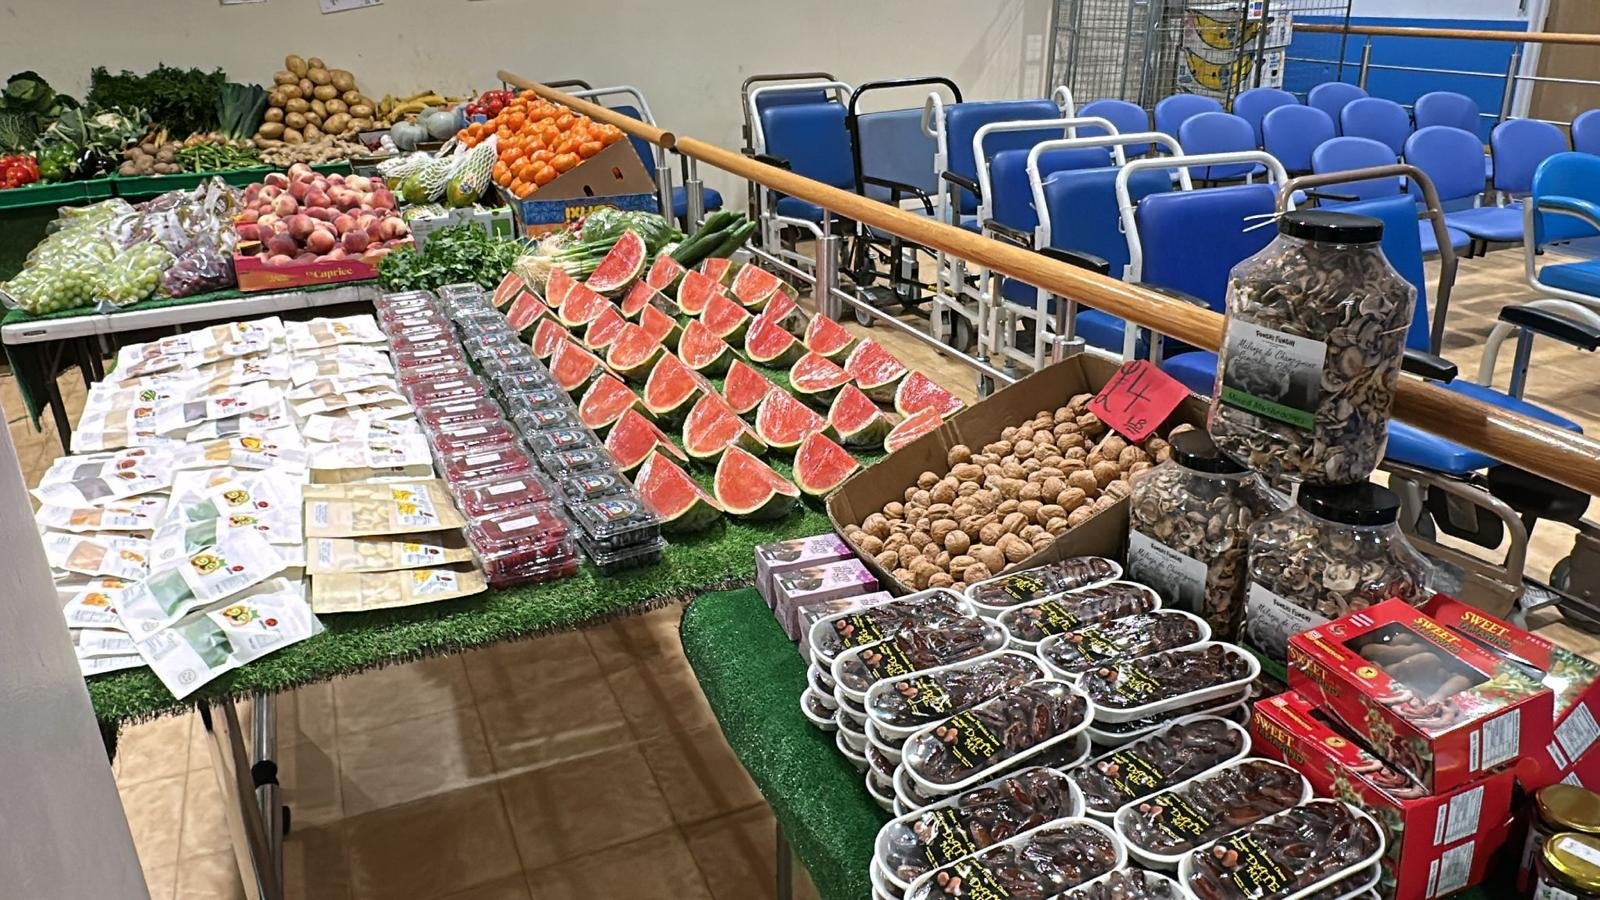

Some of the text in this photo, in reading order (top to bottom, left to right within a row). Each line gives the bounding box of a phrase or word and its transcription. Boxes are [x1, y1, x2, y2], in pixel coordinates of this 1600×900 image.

[1414, 617, 1461, 643] SWEET
[1460, 611, 1510, 638] SWEET
[1289, 647, 1329, 680] SWEET
[1254, 713, 1294, 747] SWEET
